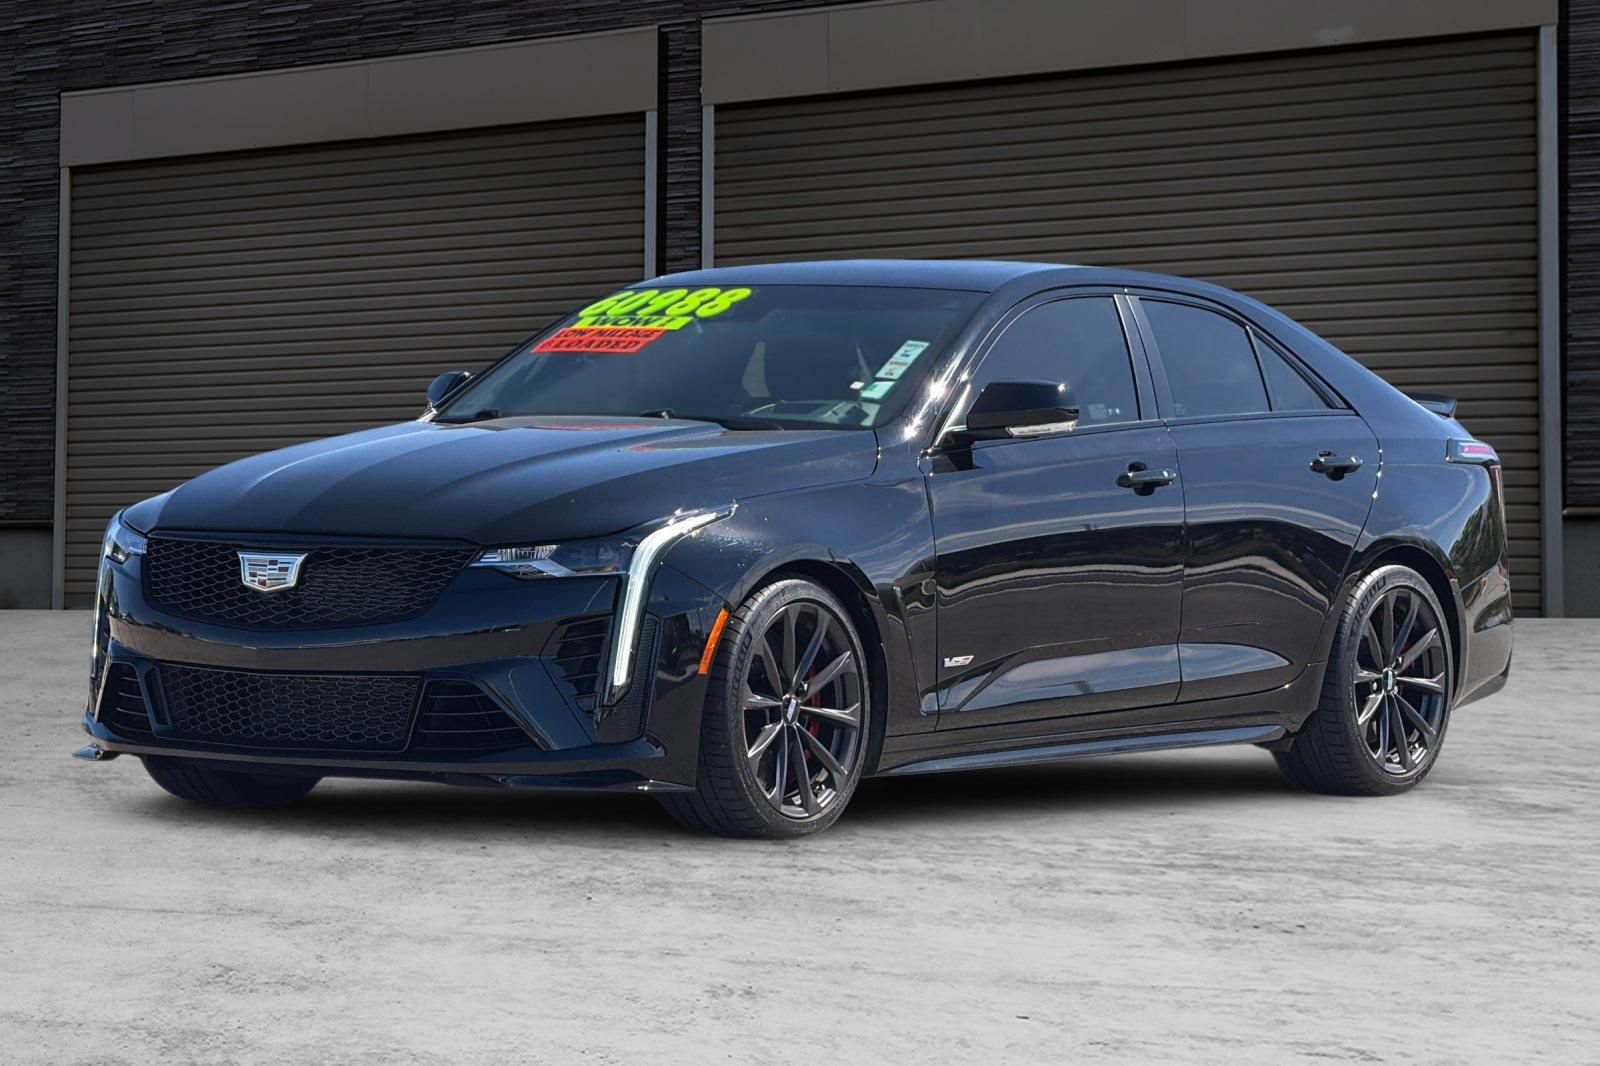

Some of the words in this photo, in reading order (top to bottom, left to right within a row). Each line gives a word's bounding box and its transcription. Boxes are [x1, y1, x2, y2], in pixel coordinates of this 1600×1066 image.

[578, 288, 752, 318] 60988
[555, 329, 593, 338] LOW
[594, 328, 661, 338] MILEAGE
[552, 340, 642, 350] LOADED
